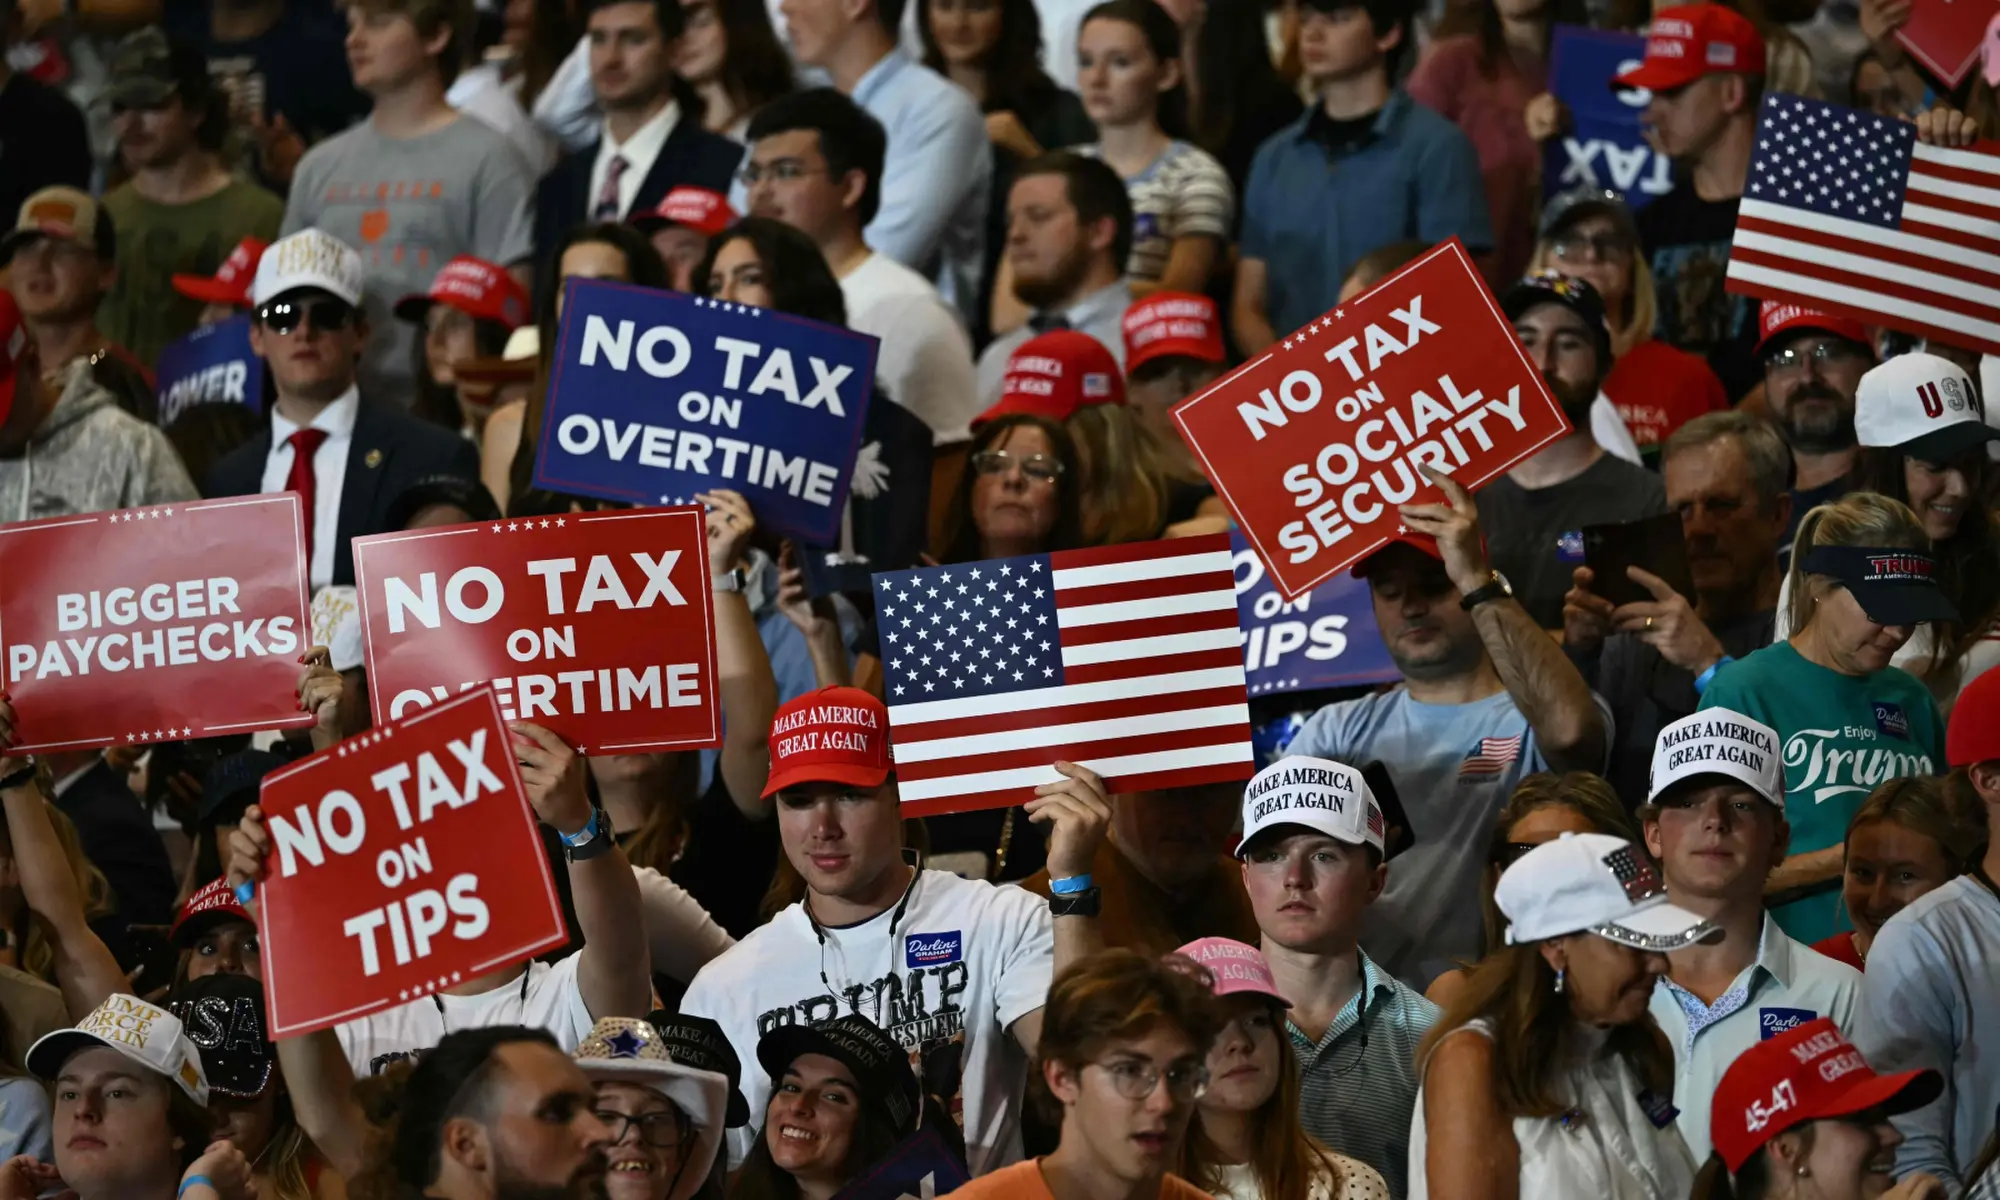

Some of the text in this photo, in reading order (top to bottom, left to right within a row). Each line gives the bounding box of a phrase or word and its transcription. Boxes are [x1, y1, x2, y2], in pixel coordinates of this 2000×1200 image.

[1559, 136, 1675, 195] TAX
[579, 315, 855, 417] NO TAX
[1236, 295, 1441, 441] NO TAX
[678, 391, 742, 429] ON
[1335, 381, 1385, 422] ON
[1916, 377, 1980, 418] USA
[1282, 374, 1483, 507] SOCIAL
[557, 414, 839, 508] OVERTIME
[1278, 385, 1527, 564] SECURITY
[384, 566, 504, 633] NO
[527, 550, 687, 615] TAX
[1233, 549, 1265, 595] O
[57, 576, 241, 632] BIGGER
[1254, 590, 1312, 619] ON
[10, 616, 298, 682] PAYCHECKS
[506, 625, 576, 662] ON
[1241, 615, 1349, 672] IPS
[390, 663, 702, 719] OERTIME
[772, 706, 877, 737] MAKE AMERICA
[1662, 721, 1772, 755] MAKE AMERICA
[1844, 725, 1877, 741] Enjoy
[778, 731, 868, 759] GREAT AGAIN
[1669, 744, 1764, 773] GREAT AGAIN
[267, 727, 505, 878] NO TAX
[1248, 768, 1354, 804] MAKE AMERICA
[1254, 792, 1344, 823] GREAT AGAIN
[376, 837, 433, 889] ON
[186, 879, 221, 909] MAKE
[344, 873, 491, 977] TIPS
[908, 939, 958, 953] Darline
[915, 948, 953, 957] GRAHAM
[84, 1011, 152, 1036] ORCE
[103, 996, 161, 1021] UMP
[659, 1025, 702, 1043] MAKE
[836, 1036, 878, 1069] AGAIN
[1790, 1030, 1840, 1065] MAKE
[1745, 1078, 1797, 1132] 45-47
